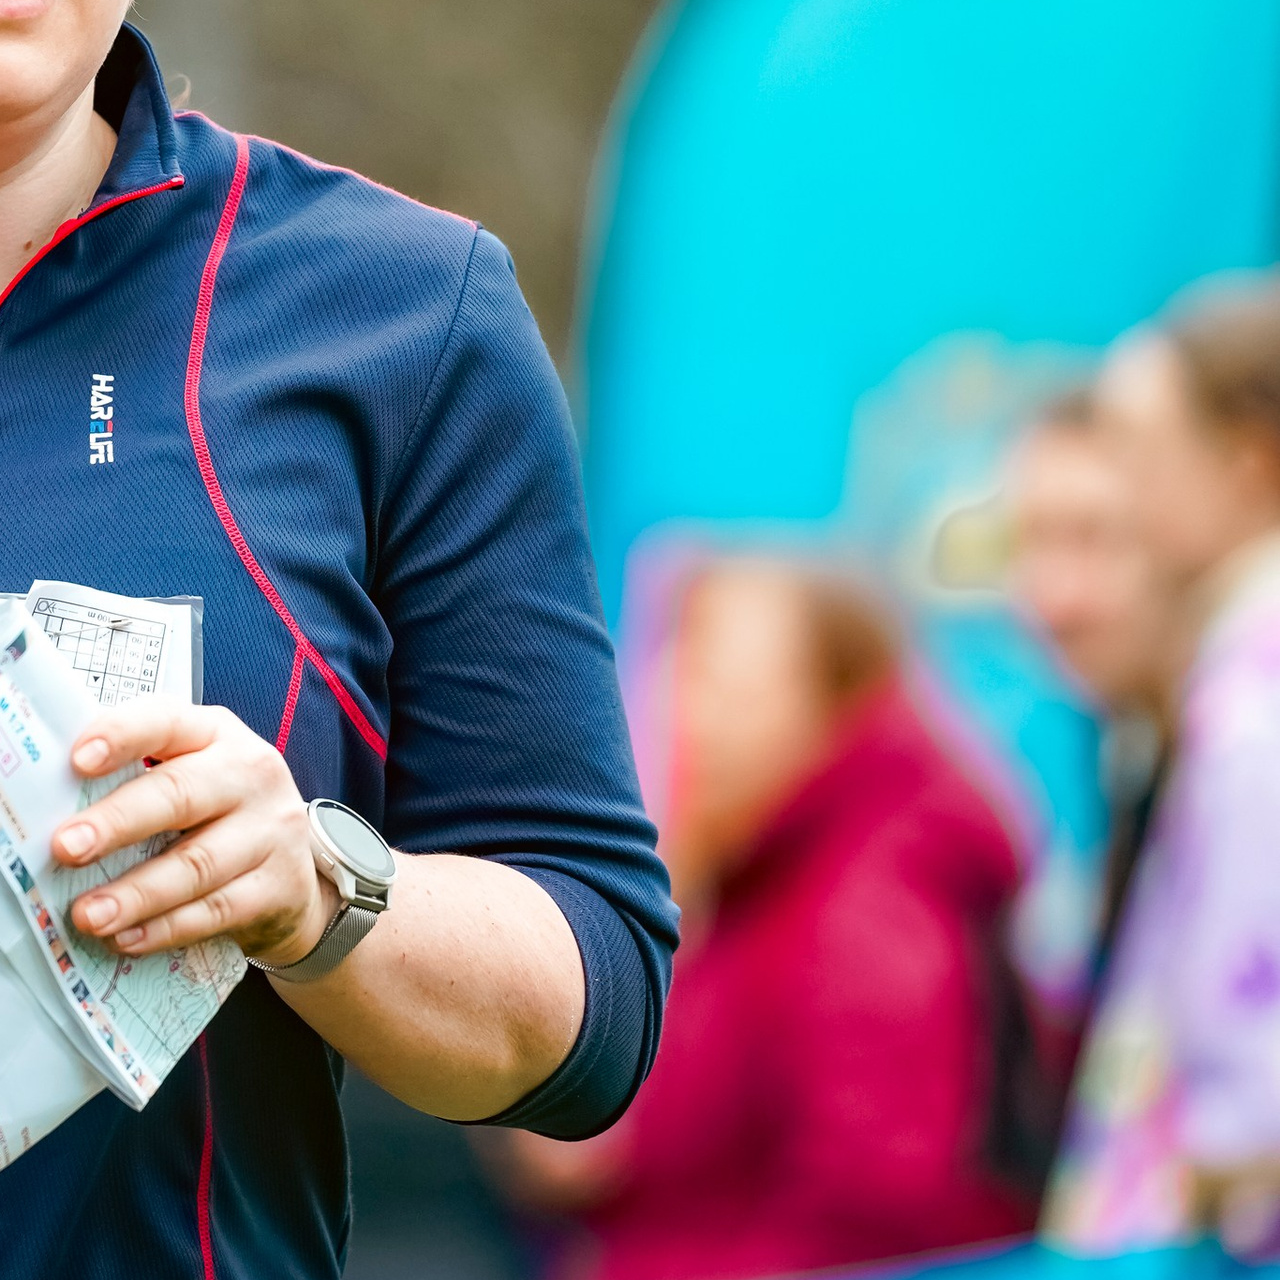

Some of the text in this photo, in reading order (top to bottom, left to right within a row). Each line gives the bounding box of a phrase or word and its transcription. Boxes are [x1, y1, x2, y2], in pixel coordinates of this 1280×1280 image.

[90, 374, 114, 465] HARELIFE
[149, 640, 160, 648] 21
[146, 653, 158, 663] 20
[143, 669, 154, 678] 19
[140, 683, 152, 693] 18
